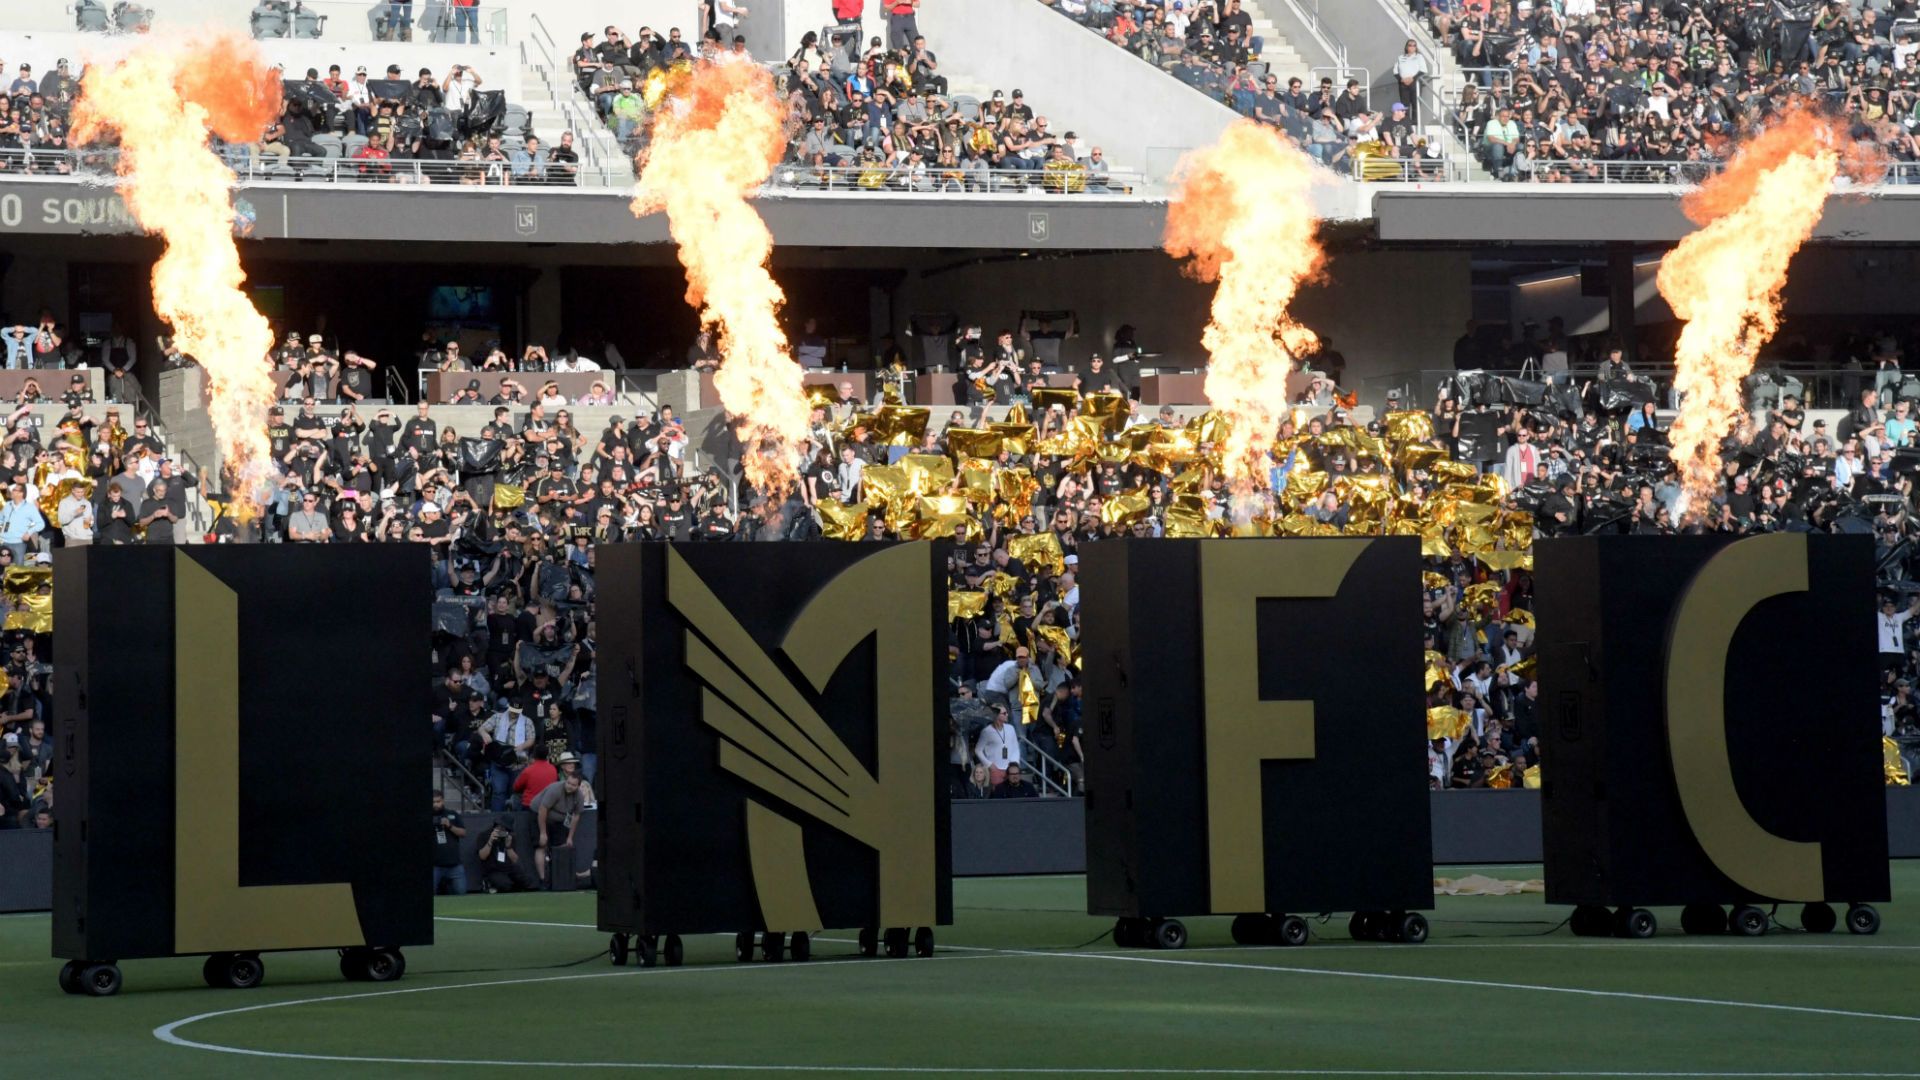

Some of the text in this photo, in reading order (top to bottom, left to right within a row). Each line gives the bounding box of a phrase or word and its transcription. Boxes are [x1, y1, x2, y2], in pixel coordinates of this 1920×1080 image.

[174, 532, 1825, 954] L A F C
